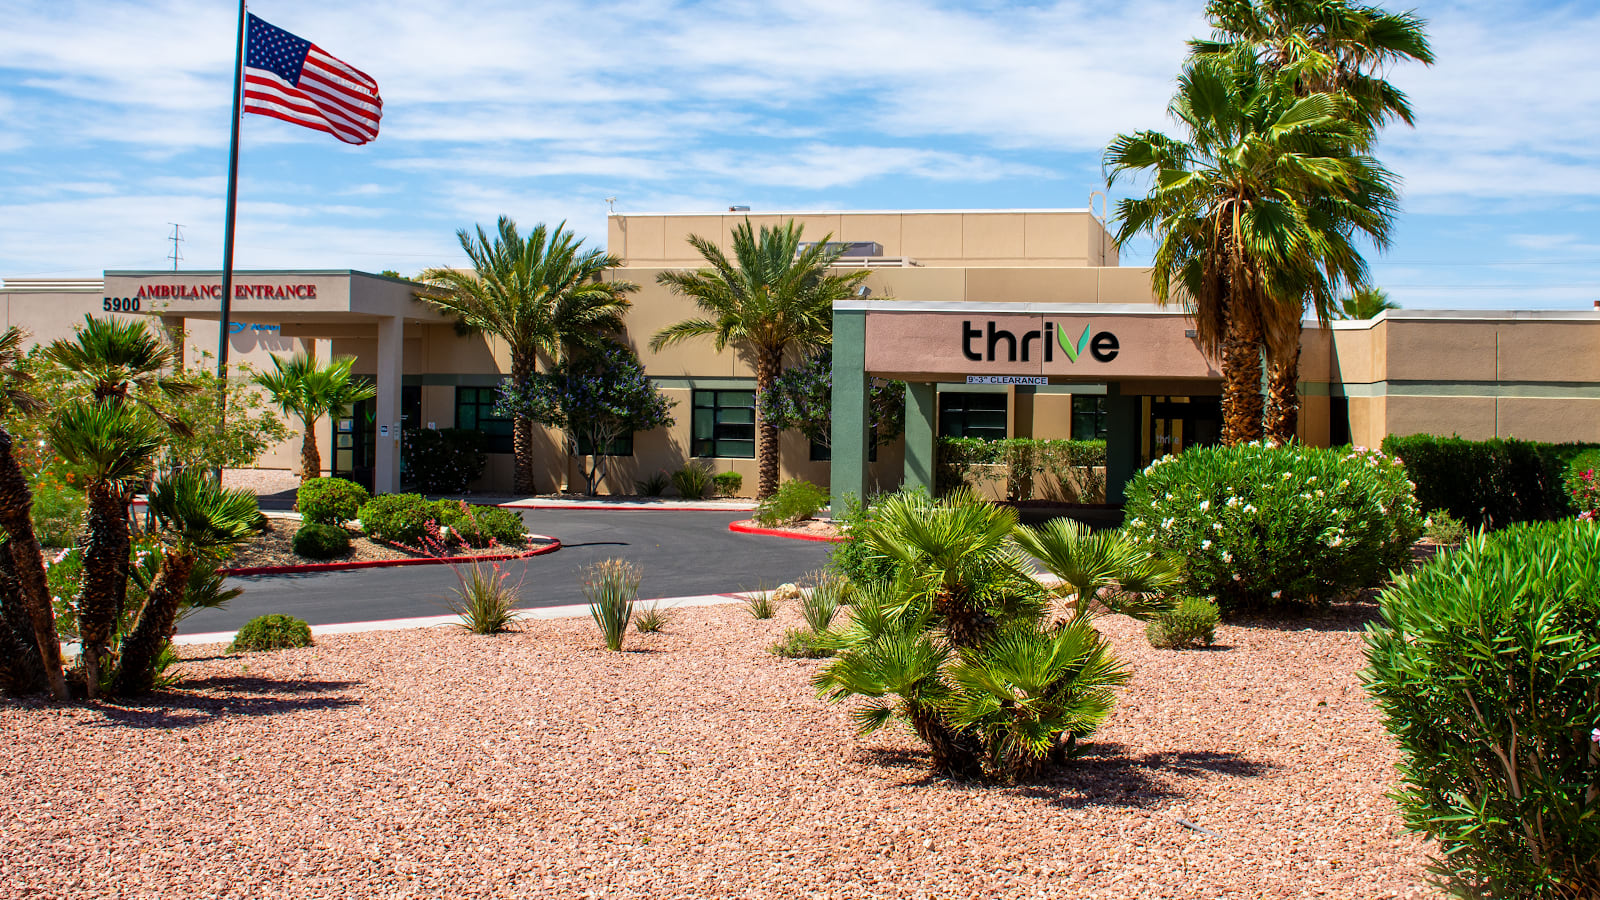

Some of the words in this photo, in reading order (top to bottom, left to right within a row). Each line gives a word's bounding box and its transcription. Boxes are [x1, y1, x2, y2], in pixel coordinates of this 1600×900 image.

[137, 285, 222, 300] AMBULANC
[235, 284, 316, 300] ENTRANCE
[103, 297, 140, 312] 5900
[962, 320, 1120, 364] thrive
[990, 376, 1047, 385] CLEARANCE
